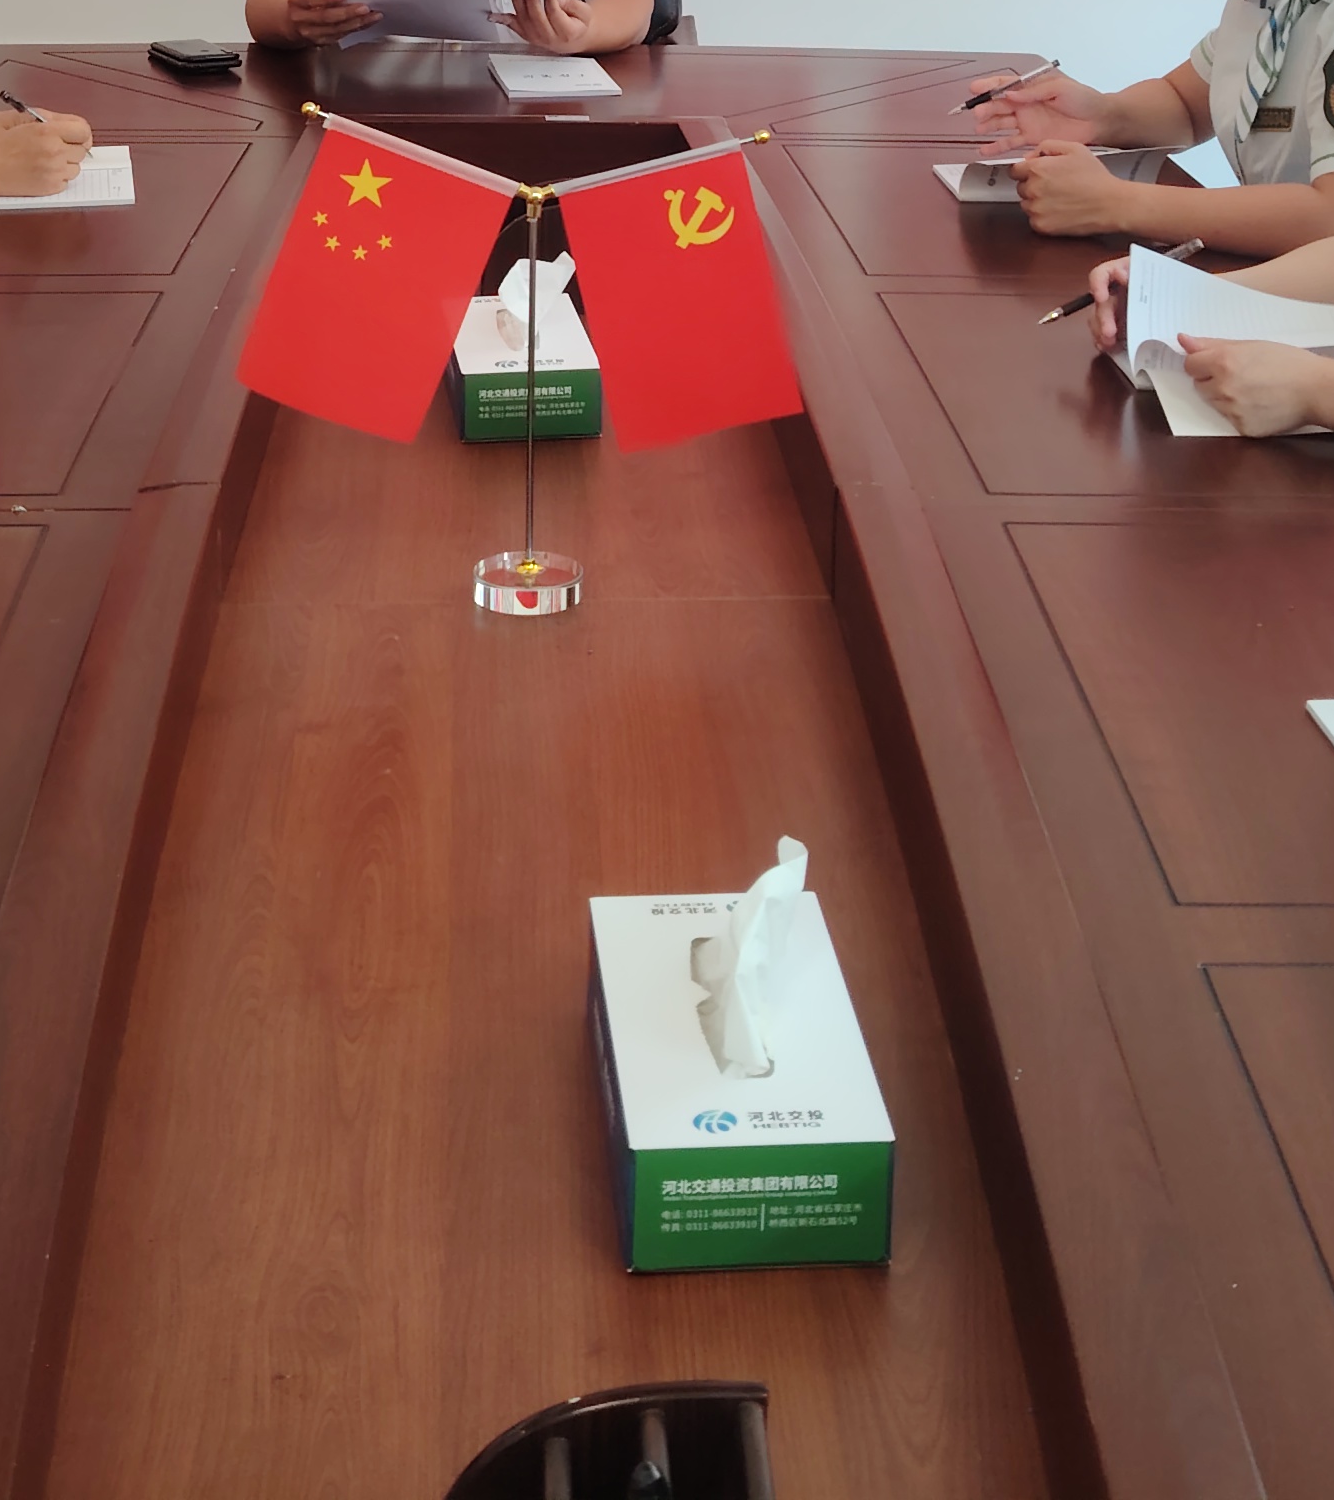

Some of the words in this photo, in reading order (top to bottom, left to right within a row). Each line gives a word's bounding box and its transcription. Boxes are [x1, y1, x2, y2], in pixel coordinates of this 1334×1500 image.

[478, 386, 572, 399] 河北交通投资团有限公司
[748, 1110, 824, 1122] 河北交投
[662, 1175, 838, 1195] 河北交通投资集团有限公司
